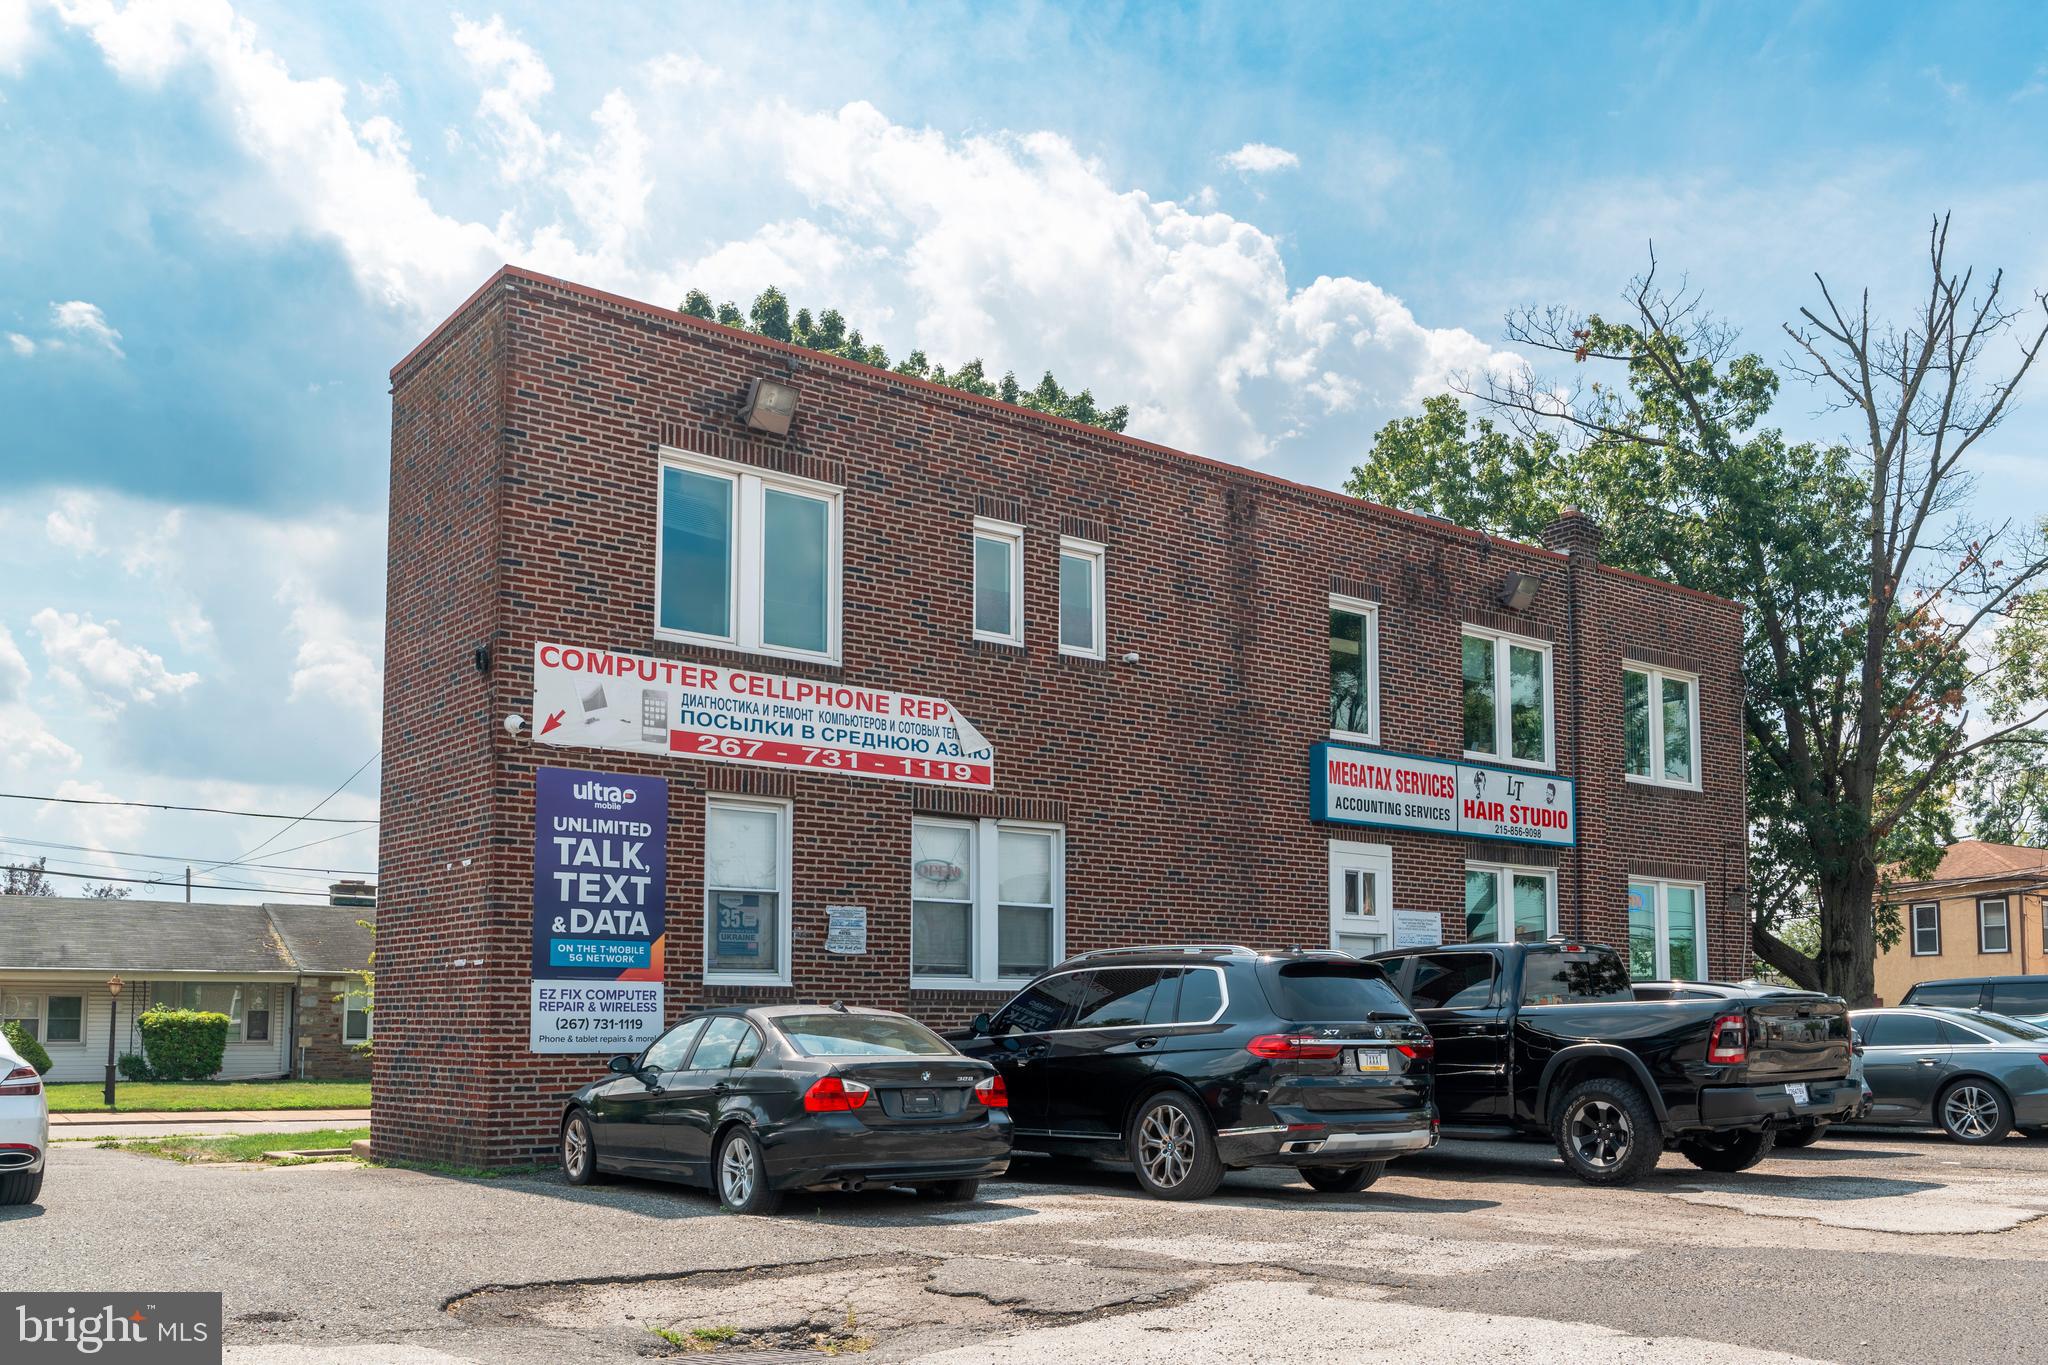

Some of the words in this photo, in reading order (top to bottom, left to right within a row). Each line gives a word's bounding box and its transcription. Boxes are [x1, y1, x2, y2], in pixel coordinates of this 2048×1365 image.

[540, 646, 718, 691] COMPUTER
[729, 673, 890, 715] CELLPHONE
[900, 697, 954, 723] REP
[681, 693, 760, 716] ДИАГНОСТИКА
[762, 704, 770, 716] И
[773, 705, 813, 722] РЕМОНТ
[819, 710, 887, 731] КОМПЬЮТЕРОВ
[889, 720, 896, 732] И
[898, 721, 940, 738] СОТОВЫХ
[681, 710, 794, 738] ПОСЫЛКИ
[802, 725, 815, 739] В
[821, 727, 930, 753] СРЕДНЮЮ
[697, 735, 764, 758] 267
[801, 746, 858, 769] 731
[900, 759, 972, 780] 1119
[573, 781, 622, 803] ultra
[1329, 760, 1392, 791] MEGATAX
[1395, 769, 1455, 799] SERVICES
[1506, 775, 1524, 801] LT
[594, 802, 622, 810] mobile
[1335, 796, 1402, 816] ACCOUNTING
[1404, 803, 1450, 821] SERVICES
[1463, 799, 1505, 822] HAIR
[1509, 804, 1568, 830] STUDIO
[553, 816, 652, 837] UNLIMITED
[1495, 824, 1542, 838] 215-856-9098
[553, 836, 650, 873] TALK,
[553, 871, 652, 905] TEXT
[551, 916, 567, 933] &
[570, 908, 651, 936] DATA
[557, 944, 574, 953] ON
[577, 945, 597, 953] THE
[600, 945, 645, 955] T-MOBILE
[569, 954, 583, 962] 5G
[586, 954, 634, 963] NETWORK
[539, 989, 556, 999] EZ
[560, 989, 582, 1000] FIX
[586, 989, 657, 1001] COMPUTER
[539, 1001, 585, 1012] REPAIR
[588, 1002, 596, 1012] &
[600, 1002, 657, 1013] WIRELESS
[555, 1017, 590, 1031] (267)
[593, 1019, 643, 1029] 731-1119
[539, 1035, 565, 1043] Phone
[567, 1035, 573, 1043] &
[575, 1035, 598, 1043] tablet
[600, 1035, 627, 1044] repairs
[628, 1035, 634, 1043] &
